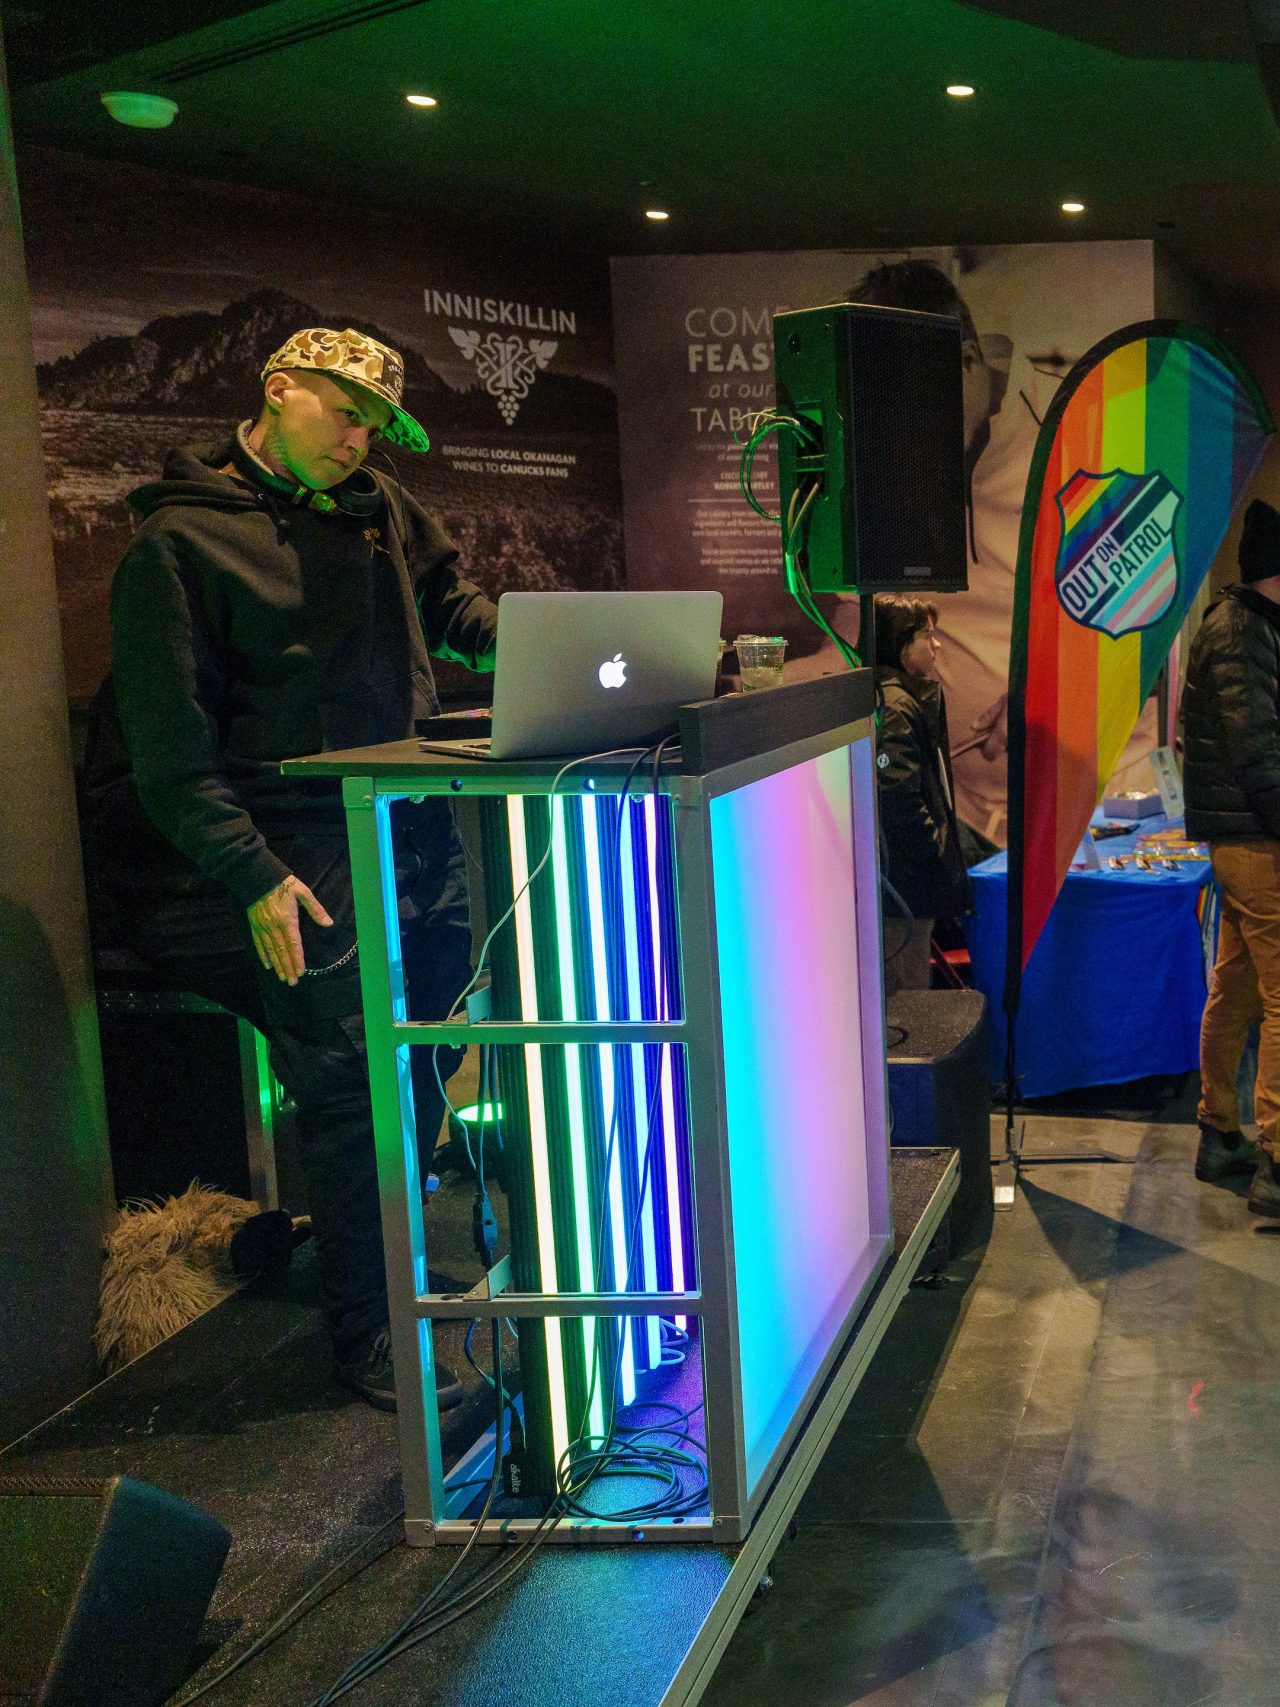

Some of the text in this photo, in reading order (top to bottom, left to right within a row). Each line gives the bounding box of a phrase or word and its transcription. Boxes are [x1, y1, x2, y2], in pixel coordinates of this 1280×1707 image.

[424, 289, 577, 335] INNISKILLIN
[685, 306, 775, 337] COM
[688, 342, 774, 373] FEAS
[708, 383, 732, 398] at
[442, 444, 577, 465] BRINGING LOCAL OKANAGAN
[452, 460, 569, 478] WINES TO CANUCKS FANS
[1061, 518, 1171, 613] OUT ON PATROL
